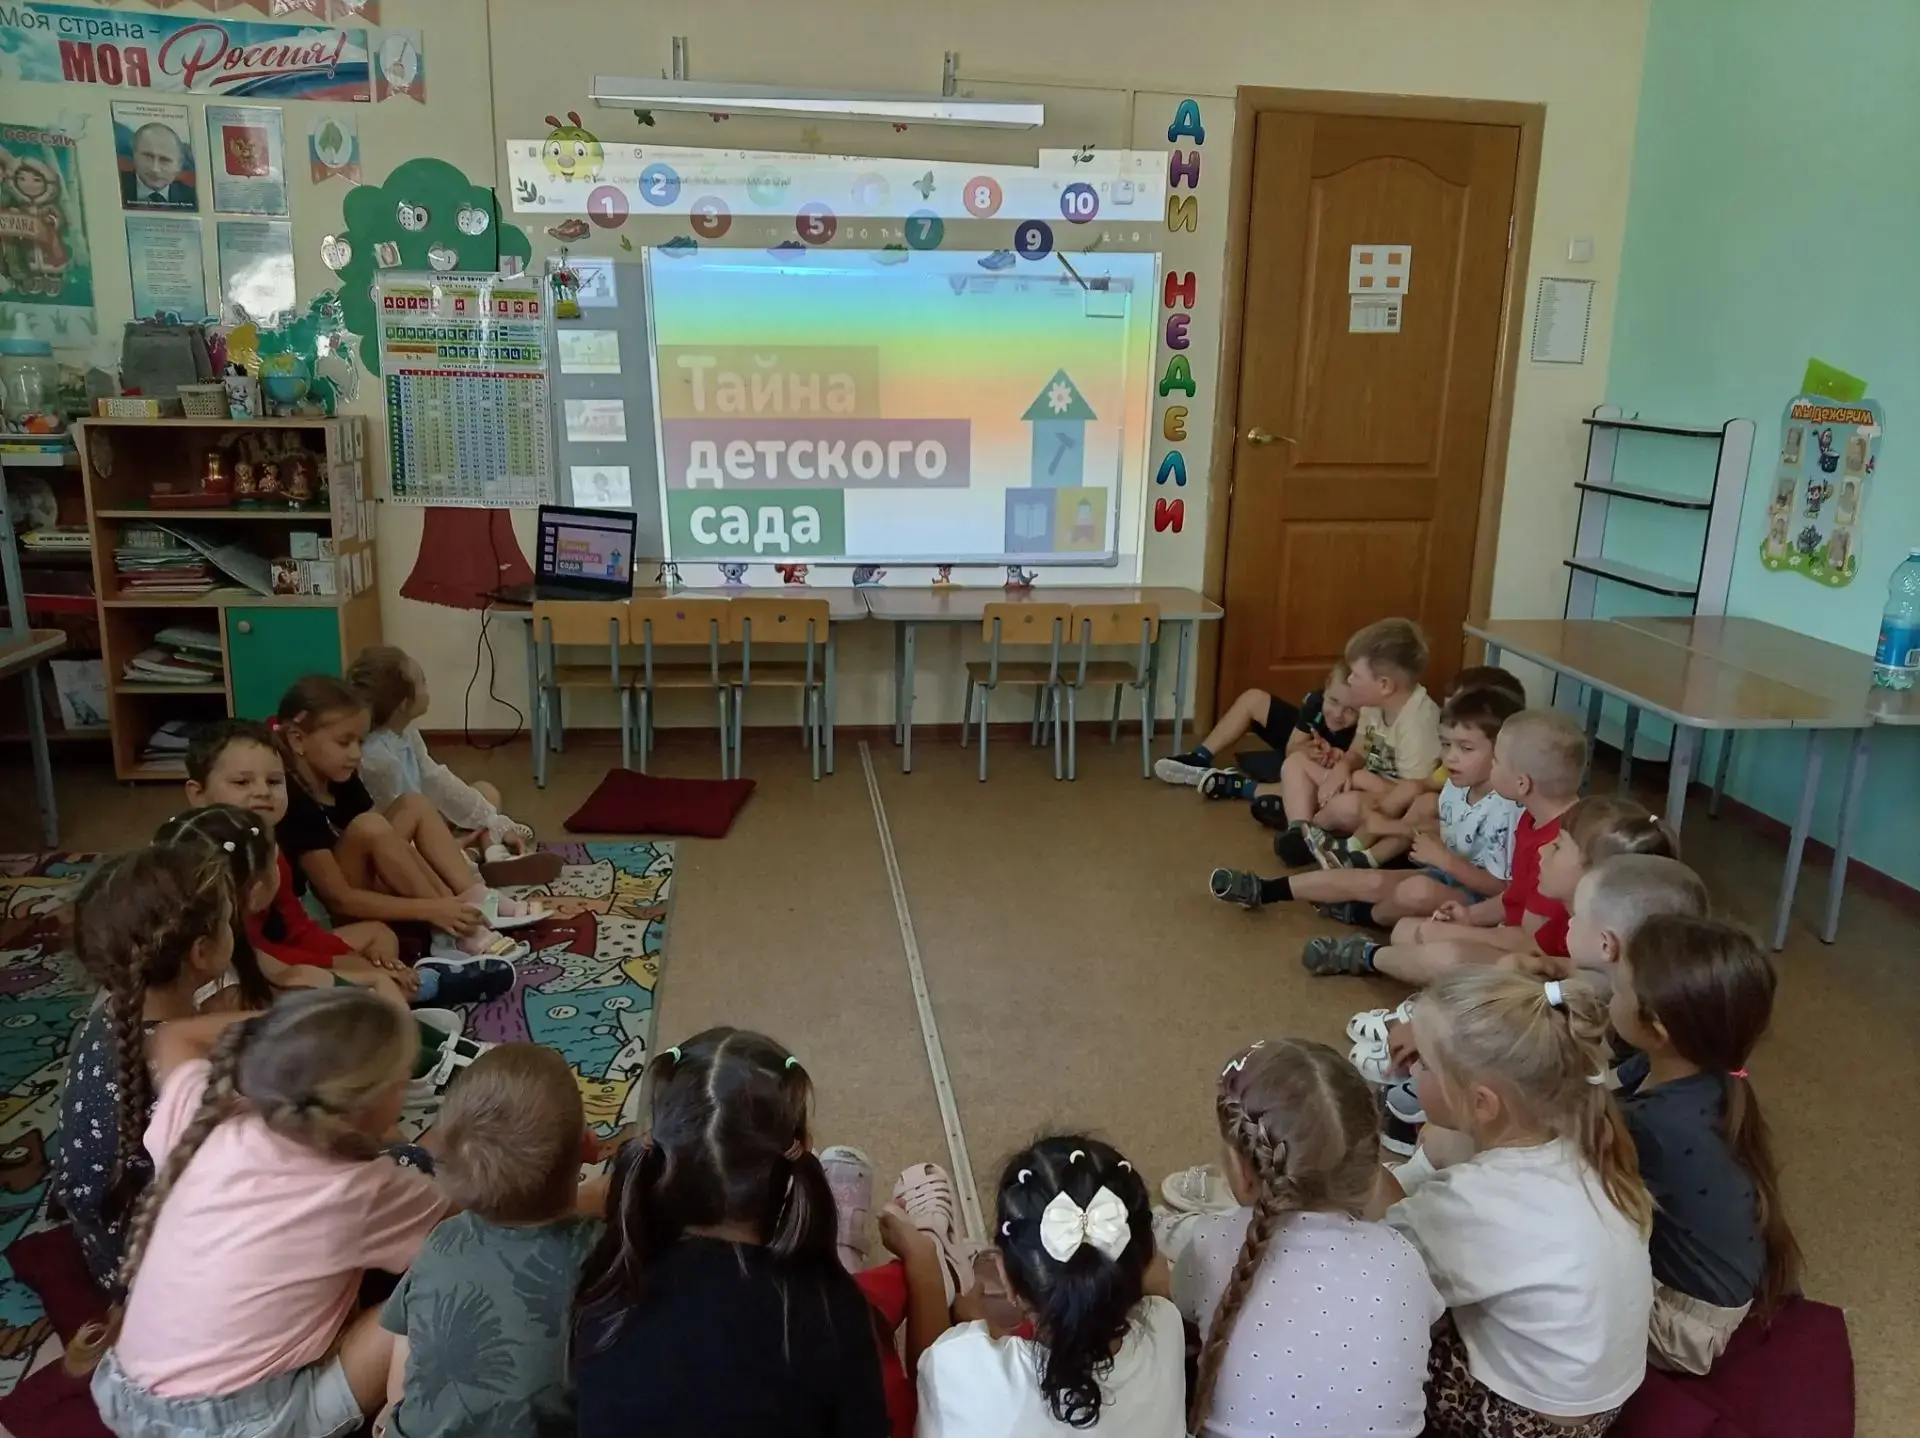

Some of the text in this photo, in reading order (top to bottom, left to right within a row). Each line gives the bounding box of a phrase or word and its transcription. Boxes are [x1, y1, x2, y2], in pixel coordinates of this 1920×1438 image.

[0, 6, 50, 31] Моя
[58, 15, 145, 41] страна
[58, 23, 347, 89] МОЯ Россия!
[1167, 99, 1206, 233] ДНИ
[650, 173, 667, 197] 2
[973, 185, 992, 208] 8
[601, 196, 615, 219] 1
[1064, 191, 1094, 216] 10
[703, 204, 719, 229] 3
[808, 213, 824, 235] 5
[916, 218, 933, 241] 7
[1025, 228, 1043, 251] 9
[676, 352, 858, 415] Тайна
[685, 438, 948, 490] детского
[689, 504, 822, 554] сада
